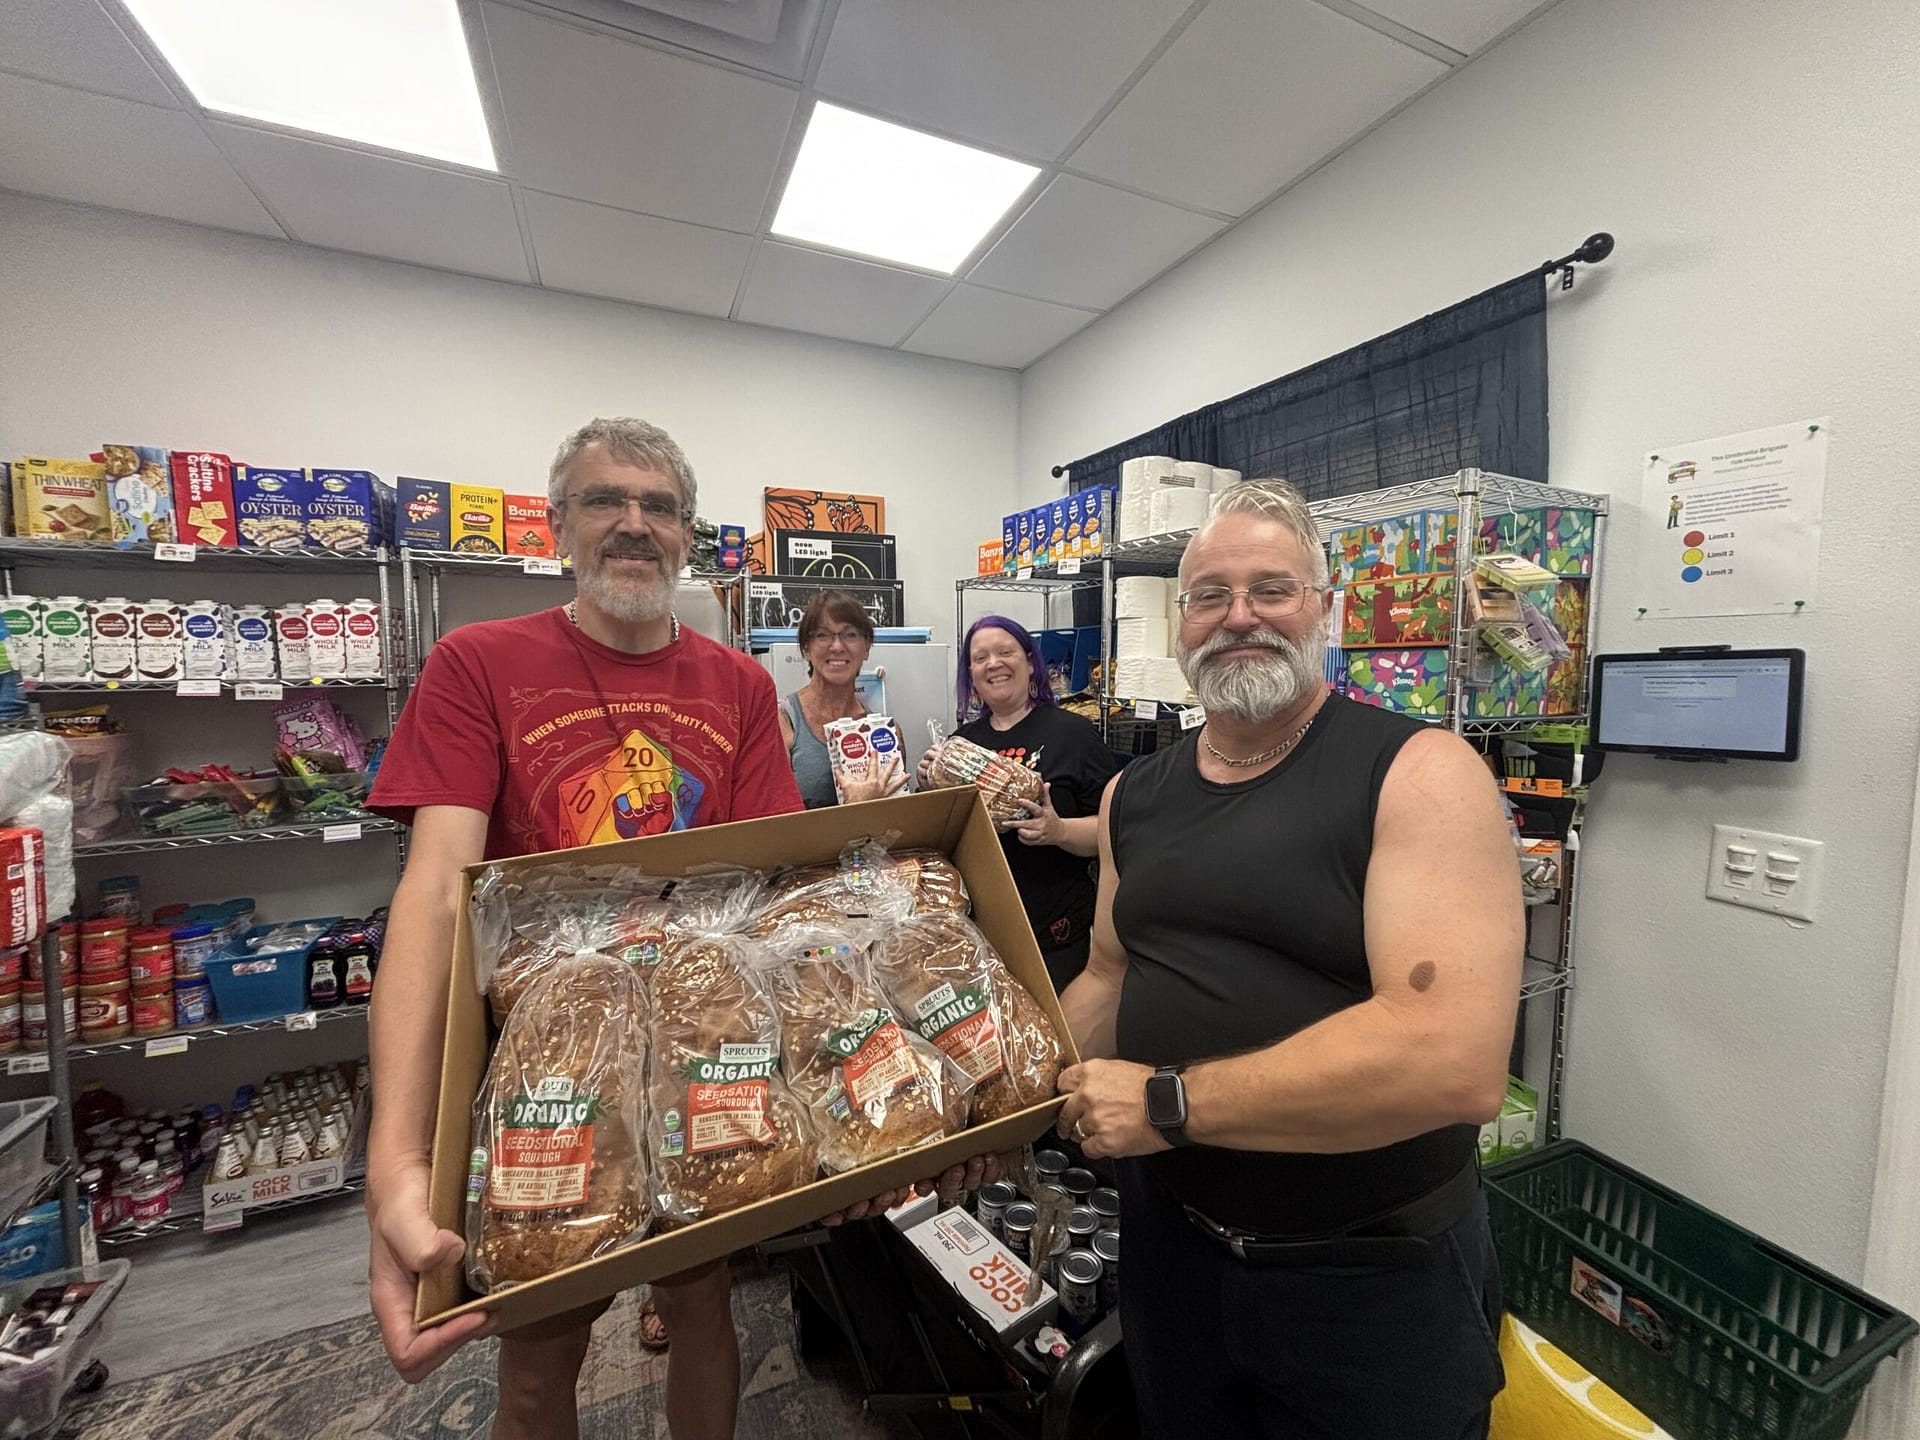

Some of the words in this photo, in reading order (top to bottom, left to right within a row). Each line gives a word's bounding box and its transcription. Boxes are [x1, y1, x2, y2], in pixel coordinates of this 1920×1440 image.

[32, 473, 60, 486] THIN
[187, 455, 201, 501] Crackers
[200, 455, 214, 492] Saltine
[460, 493, 498, 505] PROTEIN+
[240, 502, 302, 516] OYSTER
[308, 502, 365, 516] OYSTER
[409, 503, 438, 513] Barilla
[463, 514, 491, 523] Barilla
[1709, 533, 1729, 541] Limit
[1389, 607, 1413, 616] Kleenex
[1392, 677, 1416, 686] Kleenex
[522, 722, 555, 746] WHEN
[555, 706, 607, 728] SOMEONE
[607, 702, 651, 713] TTACKS
[653, 703, 672, 716] ON
[670, 711, 702, 729] PARTY
[701, 721, 734, 754] MEMBER
[623, 747, 653, 768] 20
[847, 761, 868, 769] WHOLE
[569, 781, 596, 815] 10
[918, 987, 951, 1012] SPROUTS
[920, 995, 976, 1038] ORGANIC
[724, 1047, 768, 1056] SPROUTS
[252, 1174, 291, 1189] COCO
[253, 1183, 291, 1199] MILK
[968, 1266, 1022, 1313] COCO
